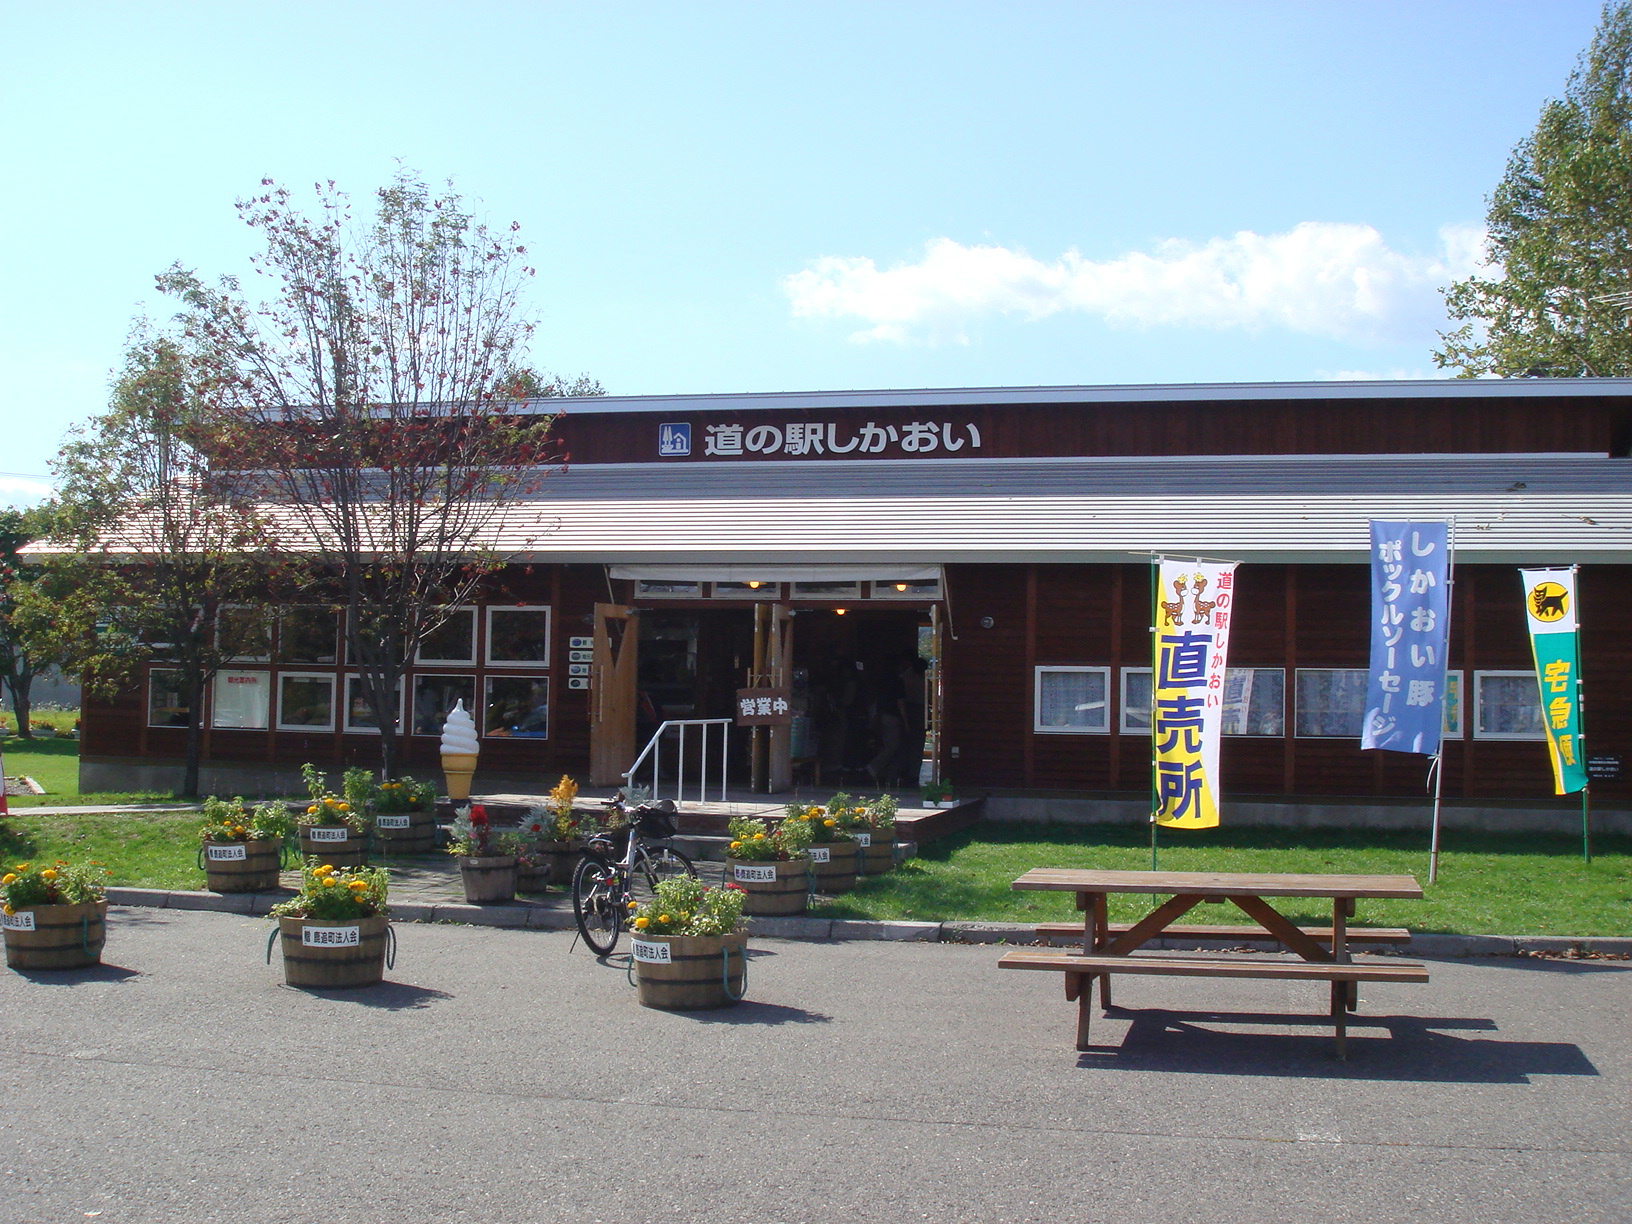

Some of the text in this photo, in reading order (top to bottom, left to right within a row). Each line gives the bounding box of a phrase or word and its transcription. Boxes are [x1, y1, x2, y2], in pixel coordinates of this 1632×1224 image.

[704, 421, 981, 456] 道の駅しかおい
[1207, 572, 1233, 709] 道の駅しかおい
[1371, 539, 1405, 736] ポックルソーセージ
[1406, 531, 1436, 708] しかおい豚
[740, 697, 788, 716] 営業中
[1156, 630, 1213, 820] 直売所
